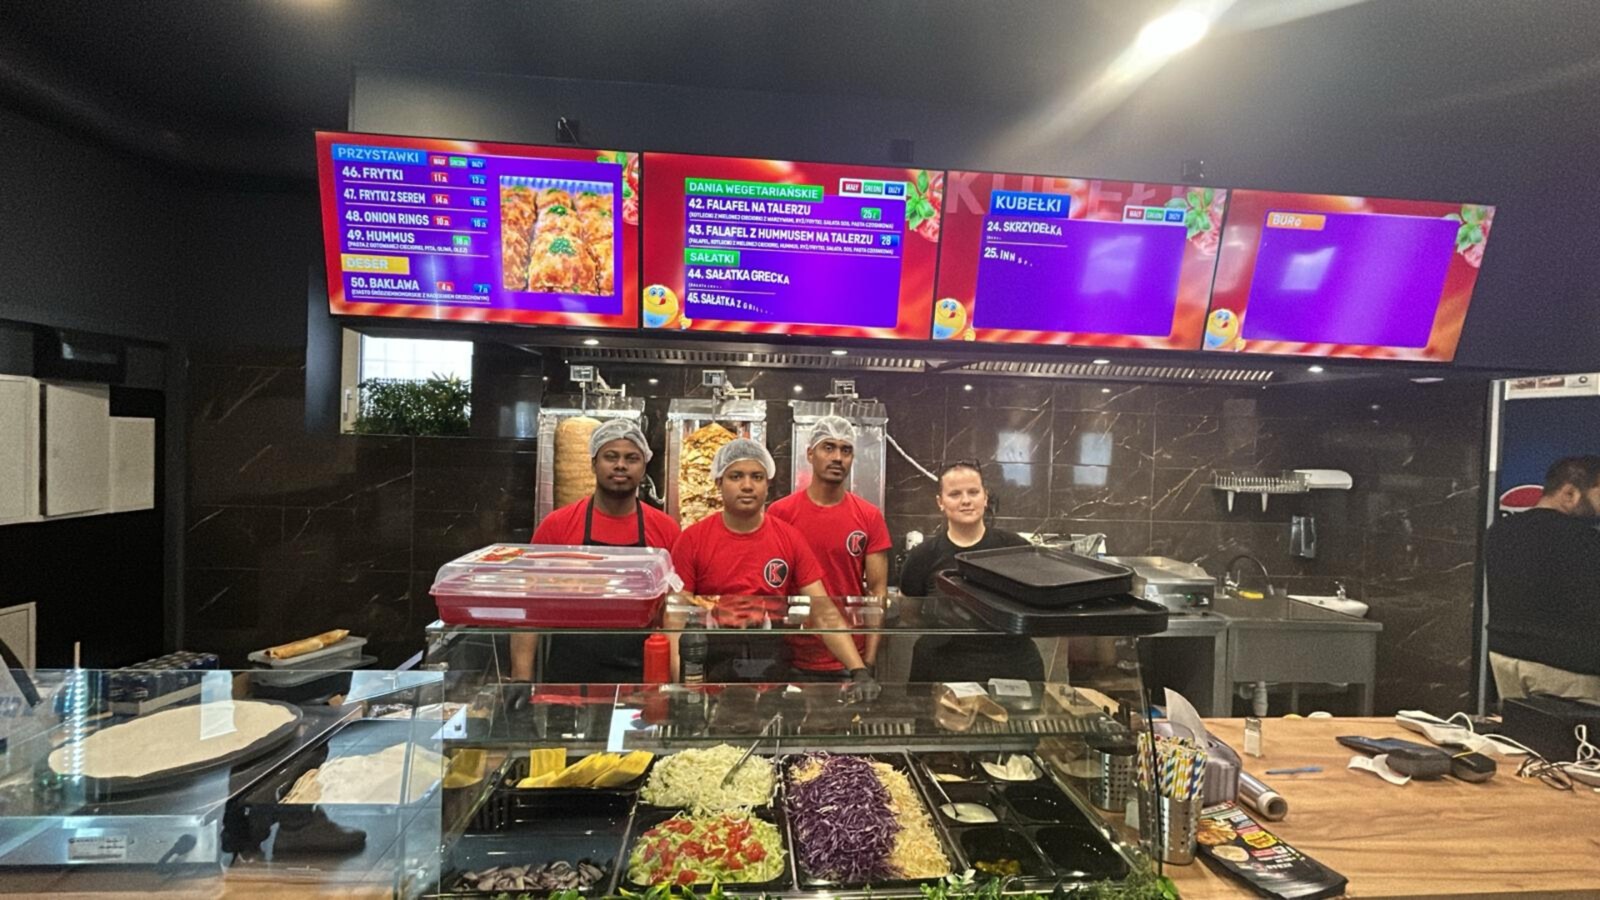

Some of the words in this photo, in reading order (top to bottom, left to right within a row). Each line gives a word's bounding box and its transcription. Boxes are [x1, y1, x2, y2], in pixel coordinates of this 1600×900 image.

[338, 147, 418, 163] PRZYSTAWKI
[342, 166, 361, 178] 46.
[362, 167, 404, 181] FRYTKI
[344, 188, 357, 200] 47.
[359, 189, 389, 202] FRYTKI
[390, 191, 396, 203] Z
[397, 192, 426, 204] SEREM
[689, 182, 723, 194] DANIA
[725, 184, 818, 199] WEGETARIAŃSKIE
[688, 198, 705, 209] 42.
[706, 199, 750, 212] FALAFEL
[751, 202, 766, 213] NA
[766, 202, 811, 215] TALERZU
[995, 195, 1062, 212] KUBEŁKI
[345, 210, 363, 222] 48.
[364, 212, 396, 224] ONION
[398, 213, 430, 226] RINGS
[347, 230, 365, 241] 49.
[366, 231, 415, 243] HUMMUS
[688, 224, 704, 236] 43.
[706, 225, 748, 238] FALAFEL
[750, 228, 757, 238] Z
[758, 228, 814, 241] HUMMUSEM
[816, 232, 829, 242] NA
[831, 233, 873, 245] TALERZU
[987, 221, 1002, 232] 24.
[1003, 222, 1062, 236] SKRZYDEŁKA
[881, 235, 891, 246] 28
[690, 252, 734, 264] SAŁATKI
[984, 246, 999, 258] 25.
[346, 257, 388, 270] DESER
[351, 277, 368, 288] 50.
[370, 278, 420, 291] BAKLAWA
[688, 268, 704, 279] 44.
[705, 269, 750, 281] SAŁATKA
[751, 270, 790, 285] GRECKA
[687, 292, 700, 303] 45.
[700, 293, 735, 307] SAŁATKA
[736, 300, 742, 308] Z
